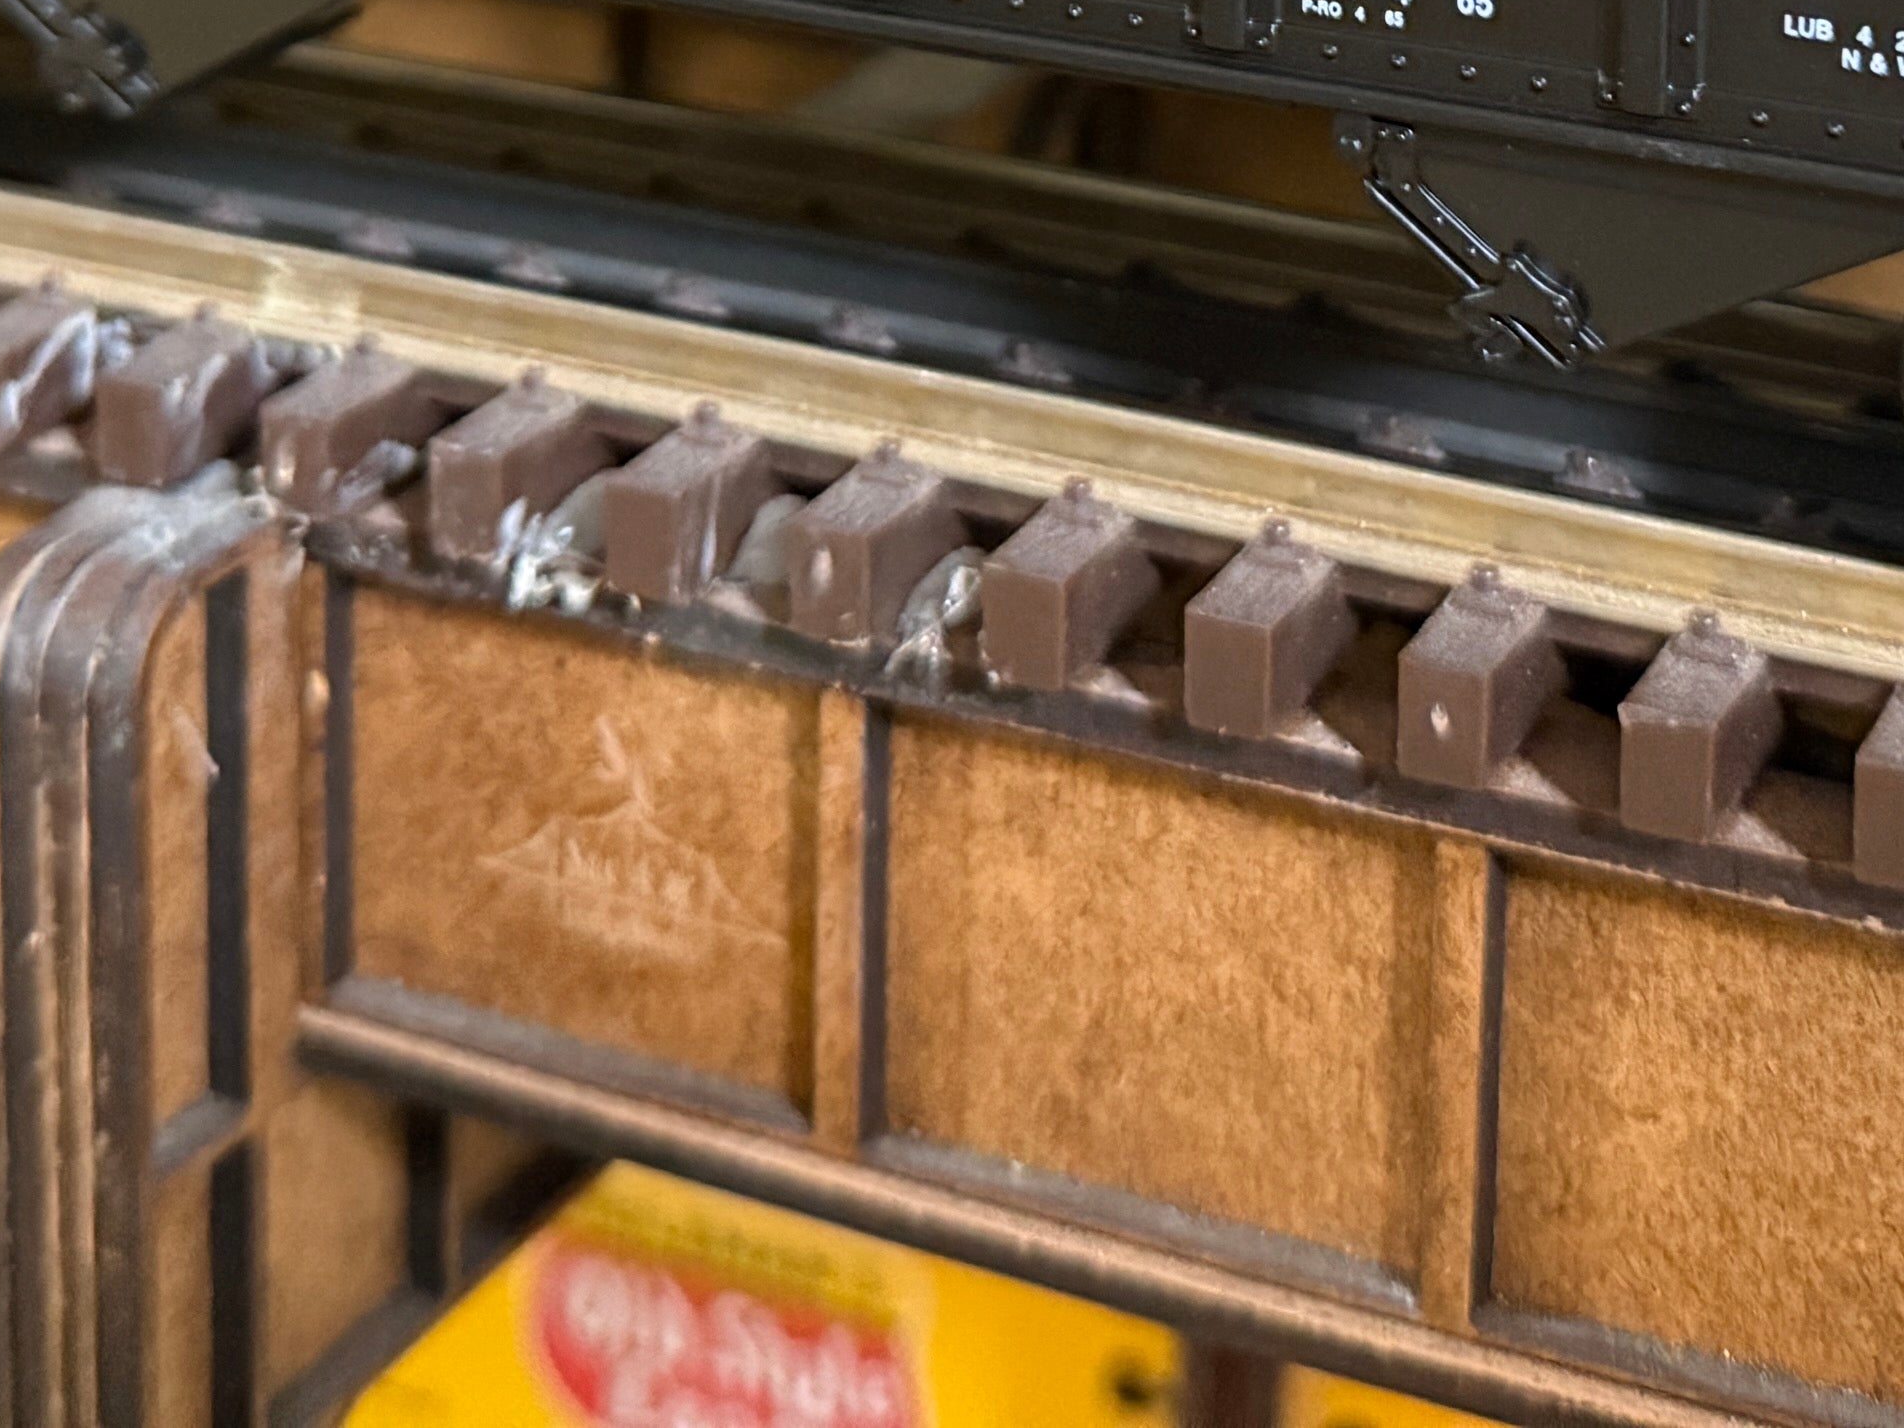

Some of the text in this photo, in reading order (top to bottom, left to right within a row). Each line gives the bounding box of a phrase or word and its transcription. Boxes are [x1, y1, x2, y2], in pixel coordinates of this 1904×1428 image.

[1354, 5, 1367, 23] 4
[1384, 9, 1406, 29] 65
[1783, 13, 1836, 42] LUB
[1855, 25, 1875, 48] 4
[1840, 47, 1863, 73] N
[1869, 52, 1890, 77] &
